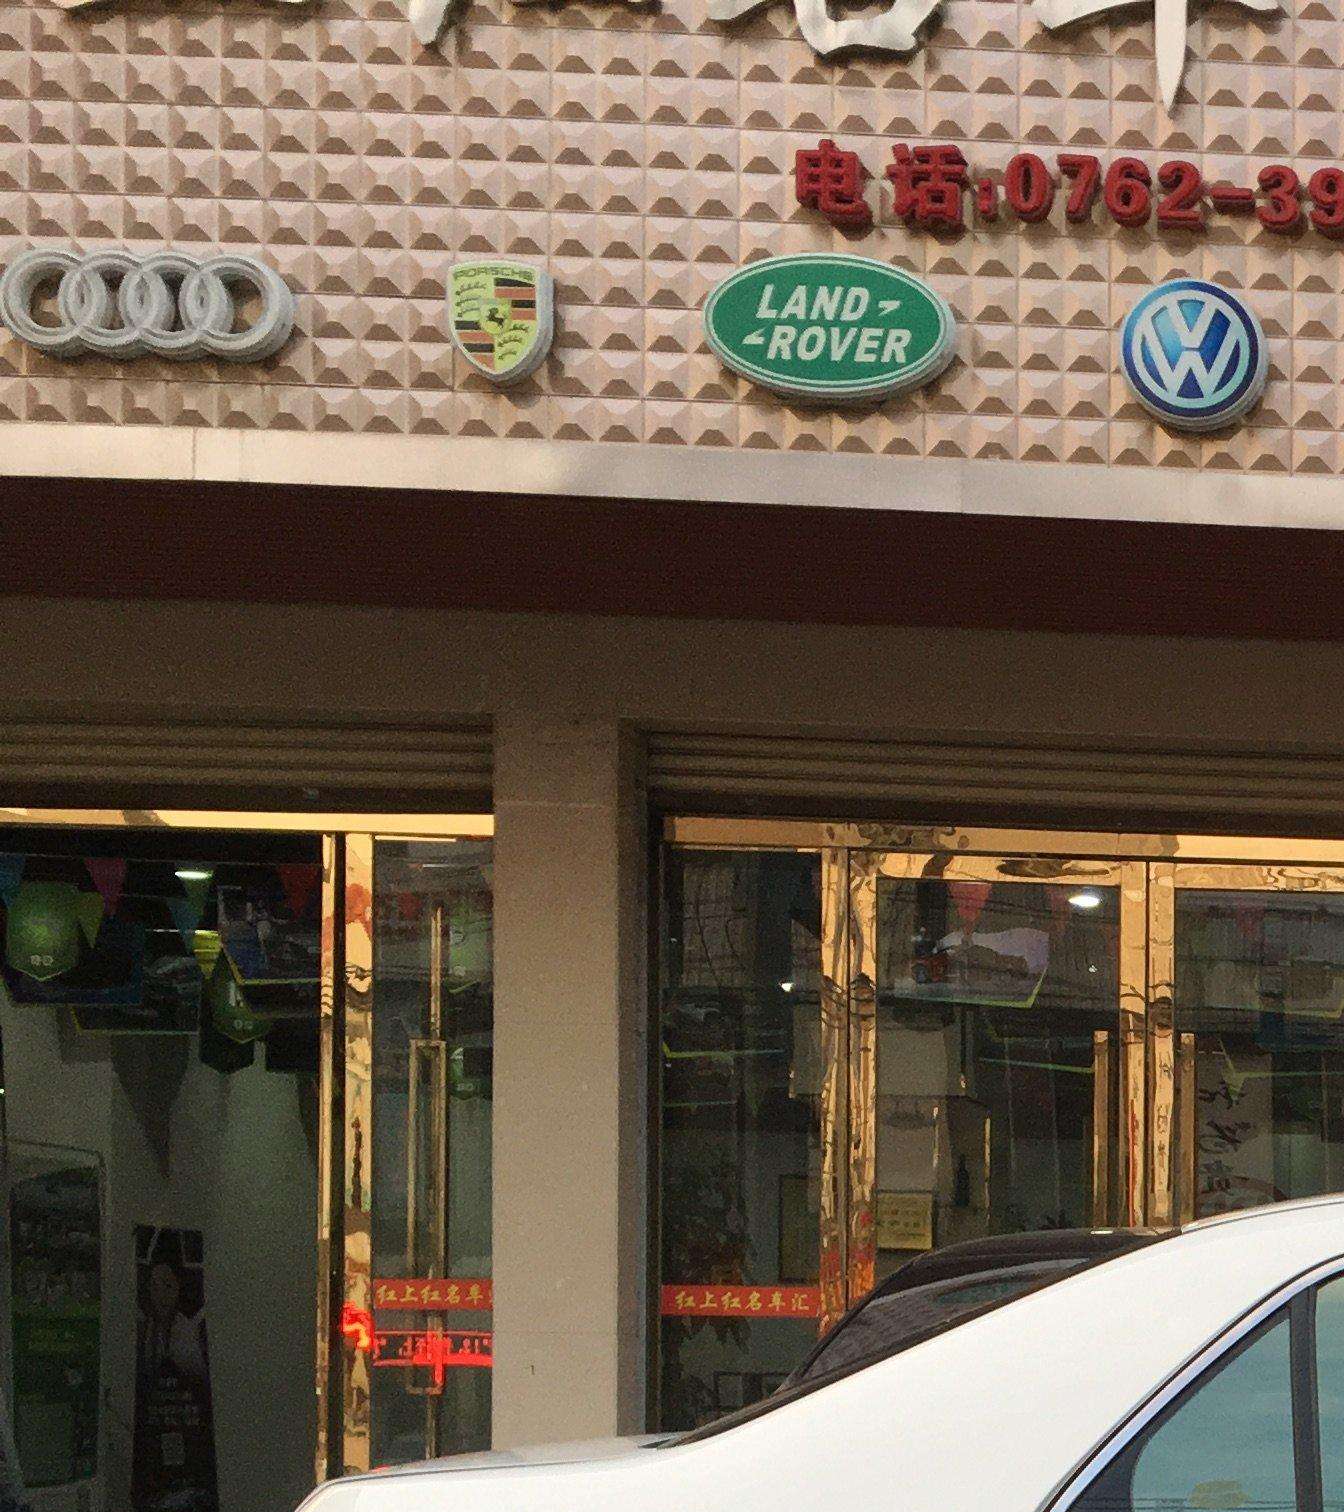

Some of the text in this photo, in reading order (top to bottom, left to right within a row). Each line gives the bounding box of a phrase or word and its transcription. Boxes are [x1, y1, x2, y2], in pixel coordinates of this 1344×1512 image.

[755, 283, 868, 321] LAND
[764, 327, 912, 365] ROVER
[376, 1283, 492, 1306] 红上红名车
[674, 1290, 811, 1312] 红上红名车汇
